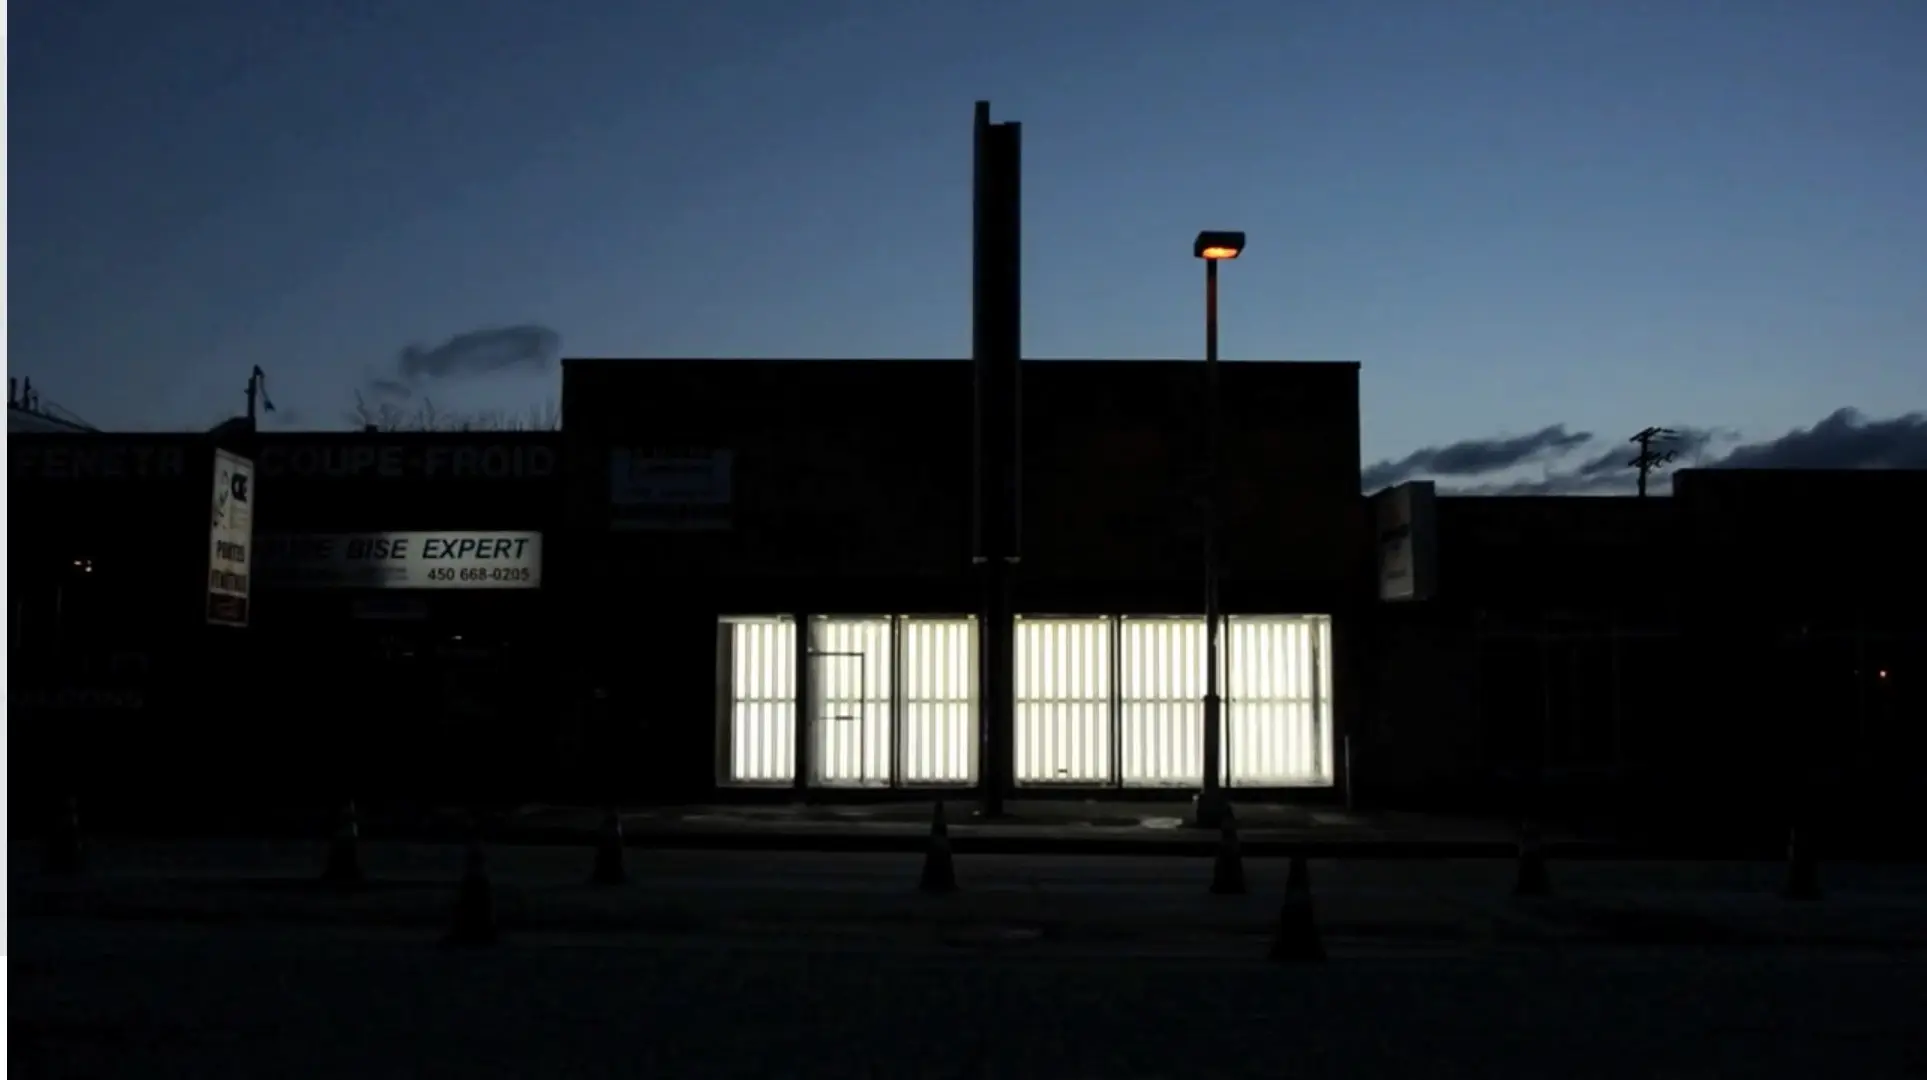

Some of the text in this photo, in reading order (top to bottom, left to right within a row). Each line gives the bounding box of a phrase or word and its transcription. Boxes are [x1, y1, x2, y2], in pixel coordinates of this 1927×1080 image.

[260, 444, 556, 479] COUPE-FROID
[346, 538, 409, 560] BISE
[422, 538, 529, 560] EXPERT
[427, 567, 530, 582] 450 668-0205
